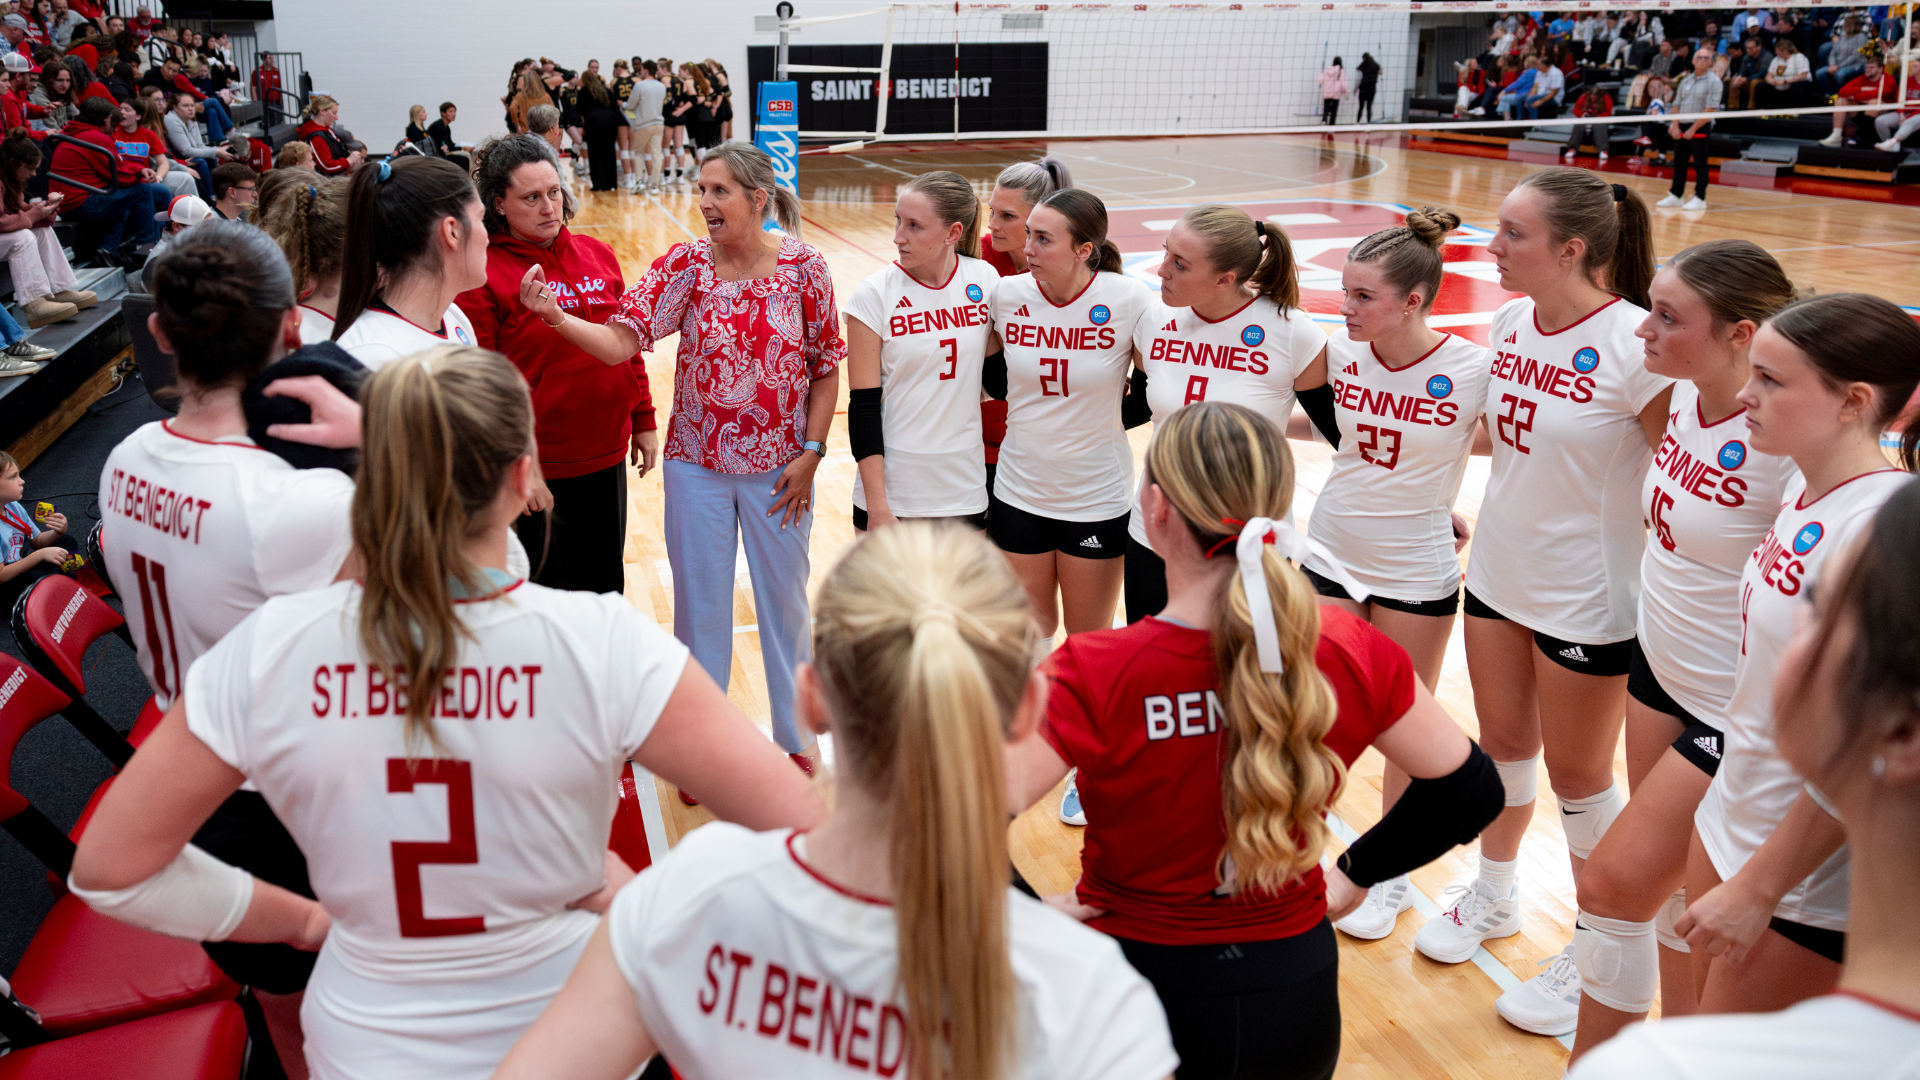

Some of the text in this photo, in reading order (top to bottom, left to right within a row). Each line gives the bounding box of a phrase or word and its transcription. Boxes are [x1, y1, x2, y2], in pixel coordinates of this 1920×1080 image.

[768, 100, 793, 112] CSB
[811, 77, 992, 101] SAINT BENEDICT
[115, 140, 150, 158] CSB
[546, 275, 606, 297] ennie
[890, 304, 989, 337] BENNIES
[1006, 322, 1115, 350] BENNIES
[939, 338, 957, 380] 3
[1150, 338, 1269, 375] BENNIES
[1578, 354, 1594, 365] BOZ
[1039, 358, 1069, 397] 21
[1432, 382, 1447, 390] BOZ
[1490, 351, 1596, 403] BENNIES
[1334, 379, 1459, 426] BENNIES
[1497, 393, 1538, 455] 22
[1356, 423, 1402, 471] 23
[1724, 448, 1740, 460] BOZ
[1655, 433, 1748, 507] ENNIES
[108, 468, 212, 545] ST. BENEDICT
[51, 620, 66, 644] SAINT
[63, 587, 88, 622] BENEDICT
[131, 551, 181, 704] 11
[1559, 650, 1589, 662] adidas
[312, 664, 542, 720] ST. BEEDICT
[1693, 737, 1721, 759] adidas
[386, 758, 486, 937] 2
[698, 942, 754, 1030] ST.
